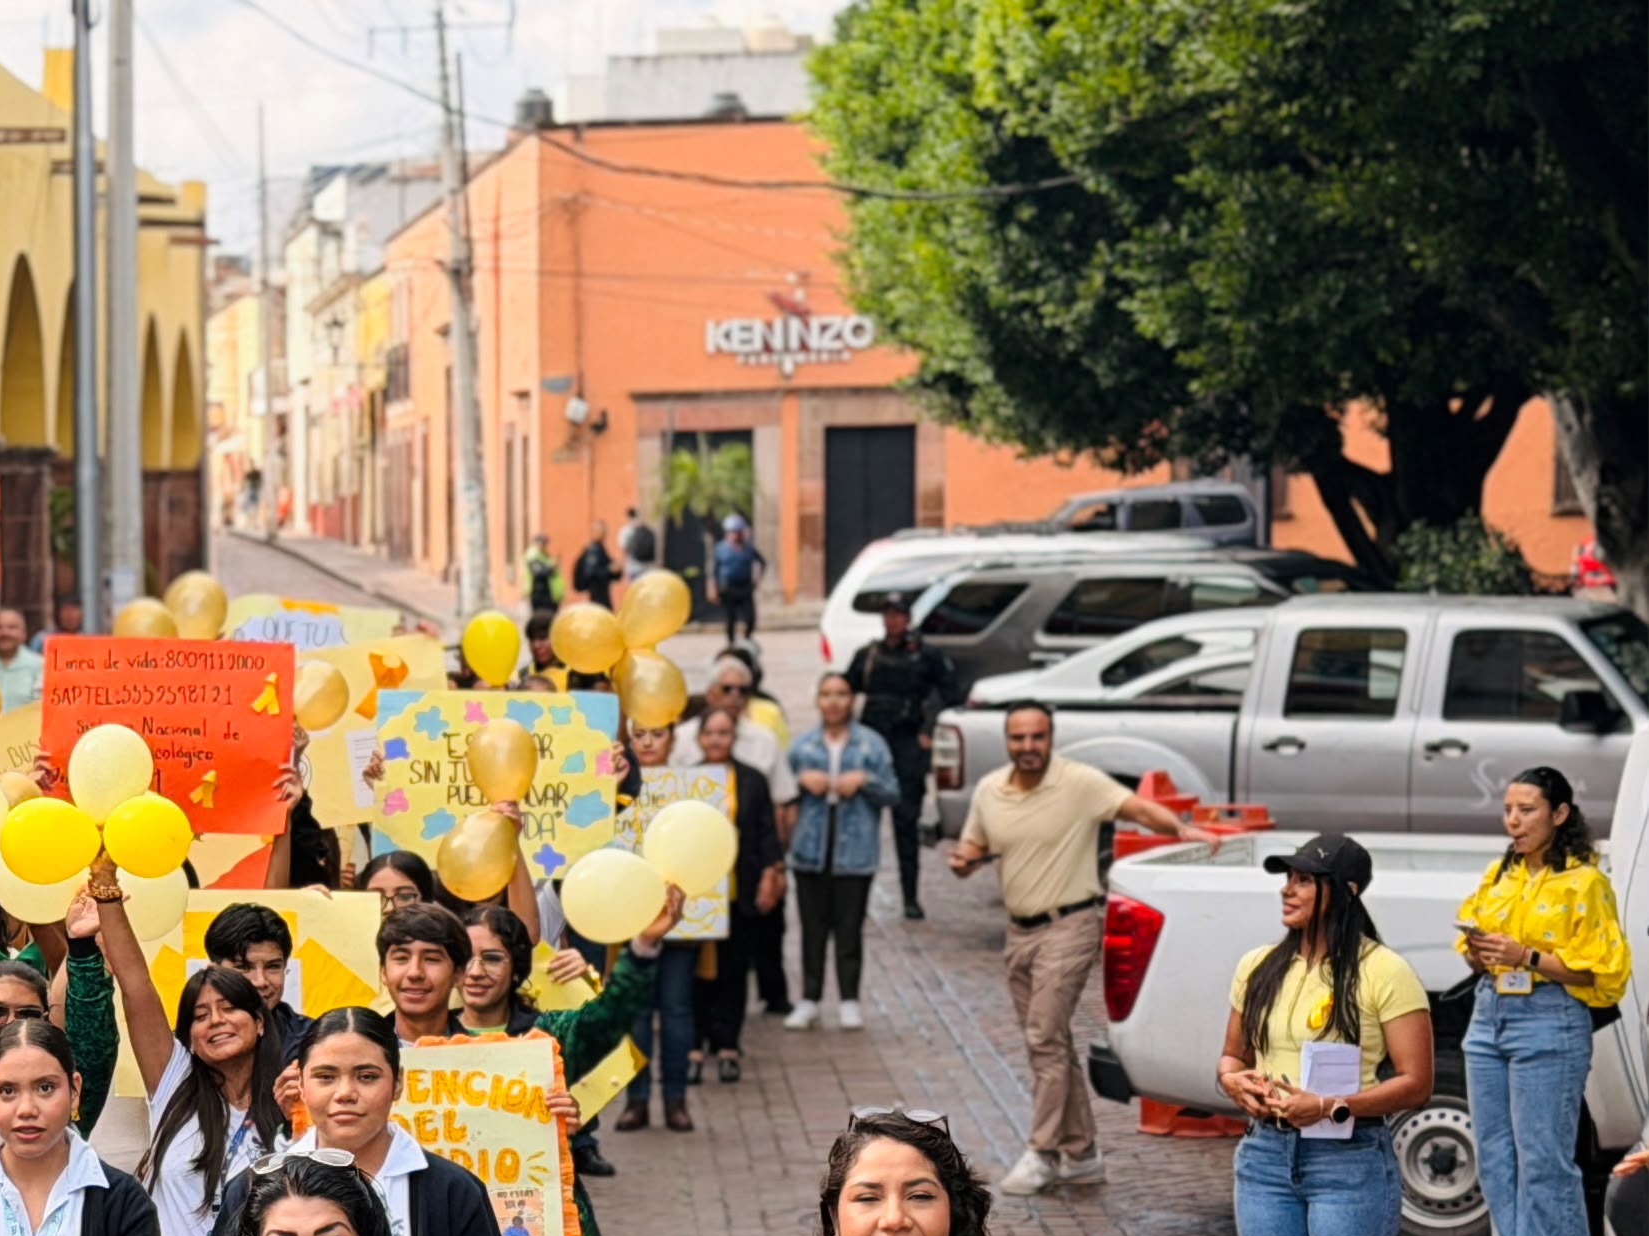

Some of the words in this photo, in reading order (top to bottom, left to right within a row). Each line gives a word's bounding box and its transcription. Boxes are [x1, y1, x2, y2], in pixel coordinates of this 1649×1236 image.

[103, 648, 119, 670] de
[142, 717, 207, 737] Nacional
[223, 721, 240, 741] de
[409, 759, 440, 784] SIN
